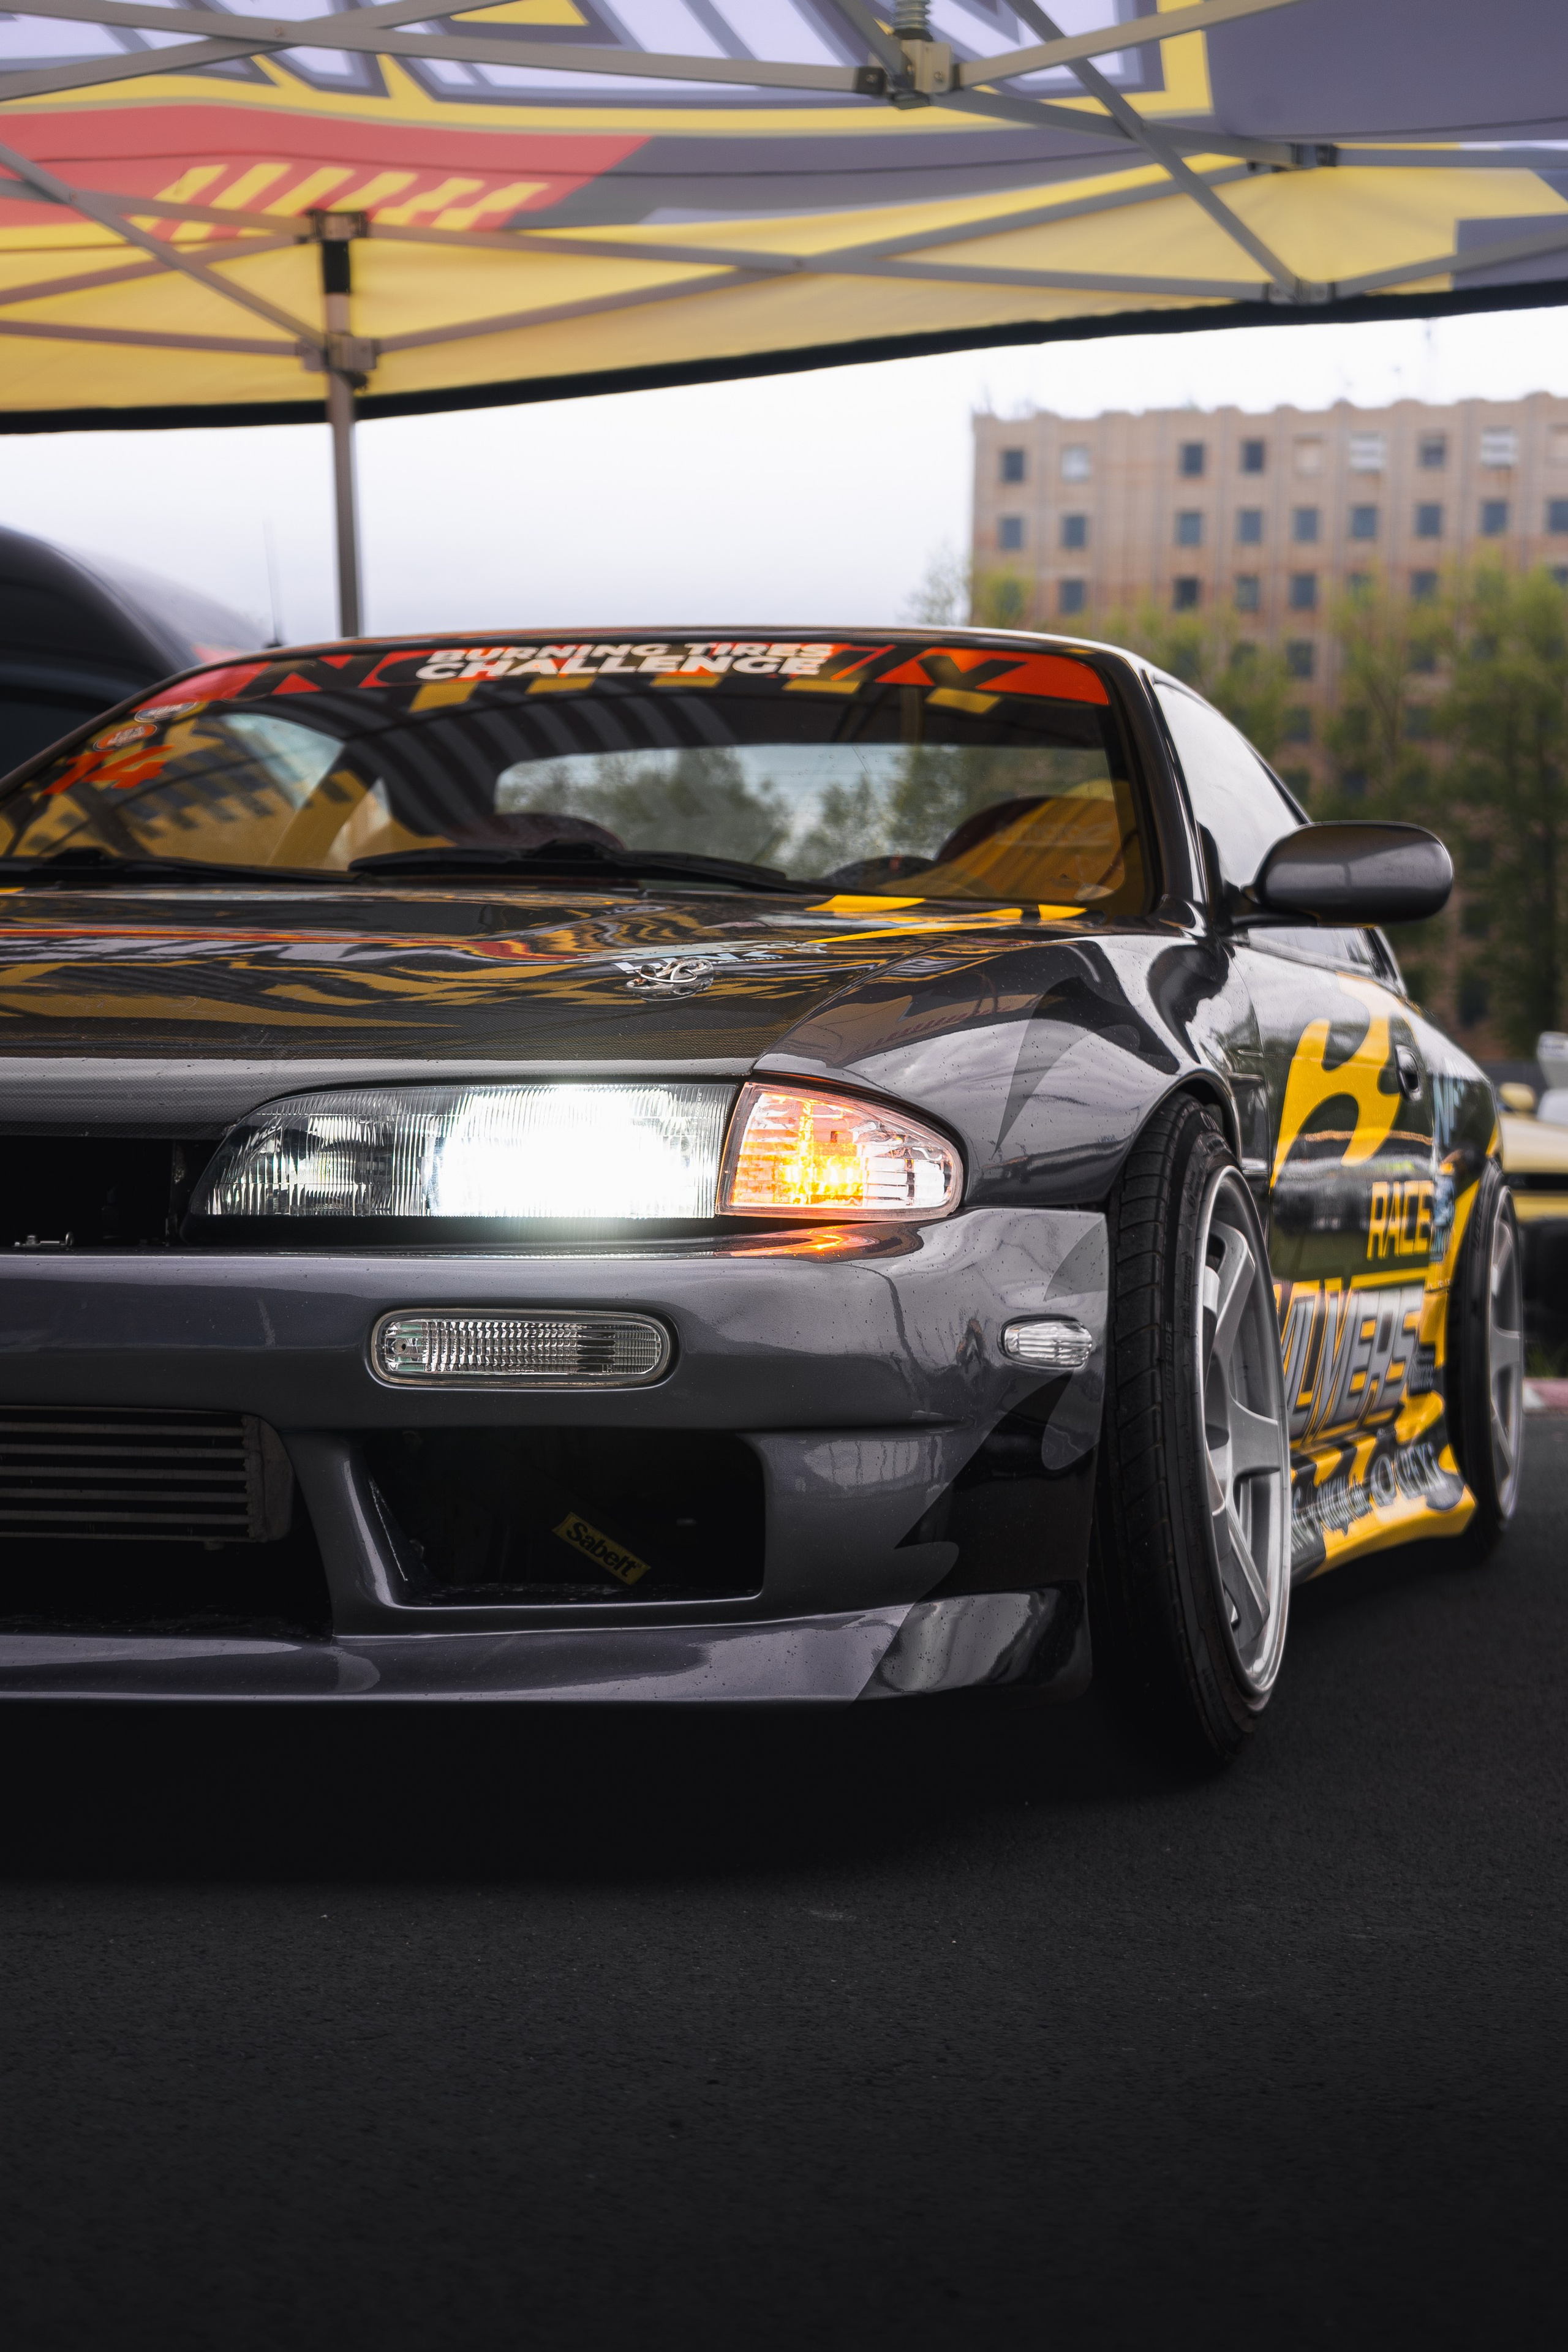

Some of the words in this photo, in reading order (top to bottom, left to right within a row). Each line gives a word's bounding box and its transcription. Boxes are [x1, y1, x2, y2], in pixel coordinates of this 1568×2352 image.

[416, 656, 828, 680] CHALLENGE
[427, 644, 671, 664] BURNING
[684, 644, 834, 657] TIRES
[42, 745, 175, 795] 14
[1366, 1180, 1434, 1260] RACE
[566, 1521, 636, 1577] Sabelt
